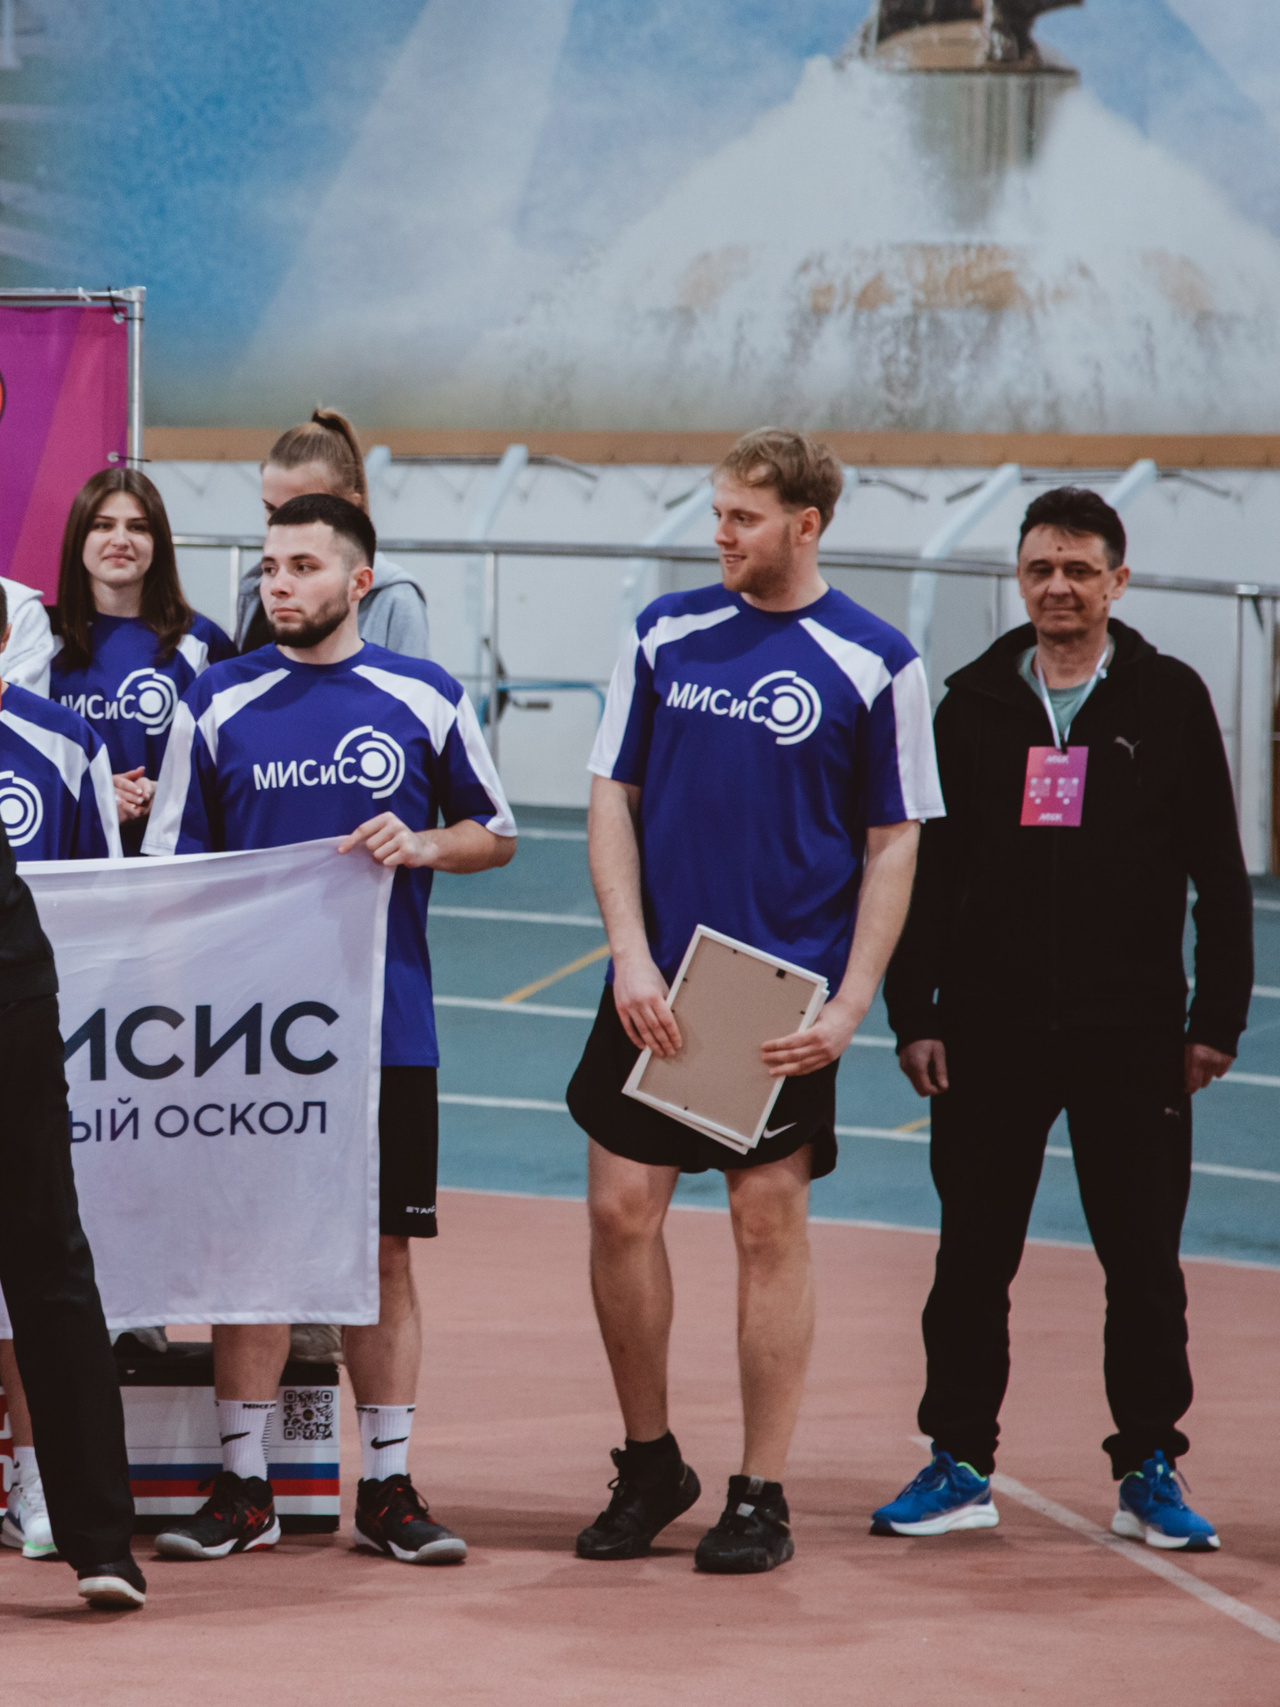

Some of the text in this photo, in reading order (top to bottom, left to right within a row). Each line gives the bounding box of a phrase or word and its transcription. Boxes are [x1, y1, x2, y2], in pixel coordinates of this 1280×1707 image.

[666, 680, 770, 723] МИСиС
[253, 756, 358, 791] МИСиС
[63, 1000, 340, 1081] ИСИС
[154, 1101, 327, 1138] ОСКОЛ
